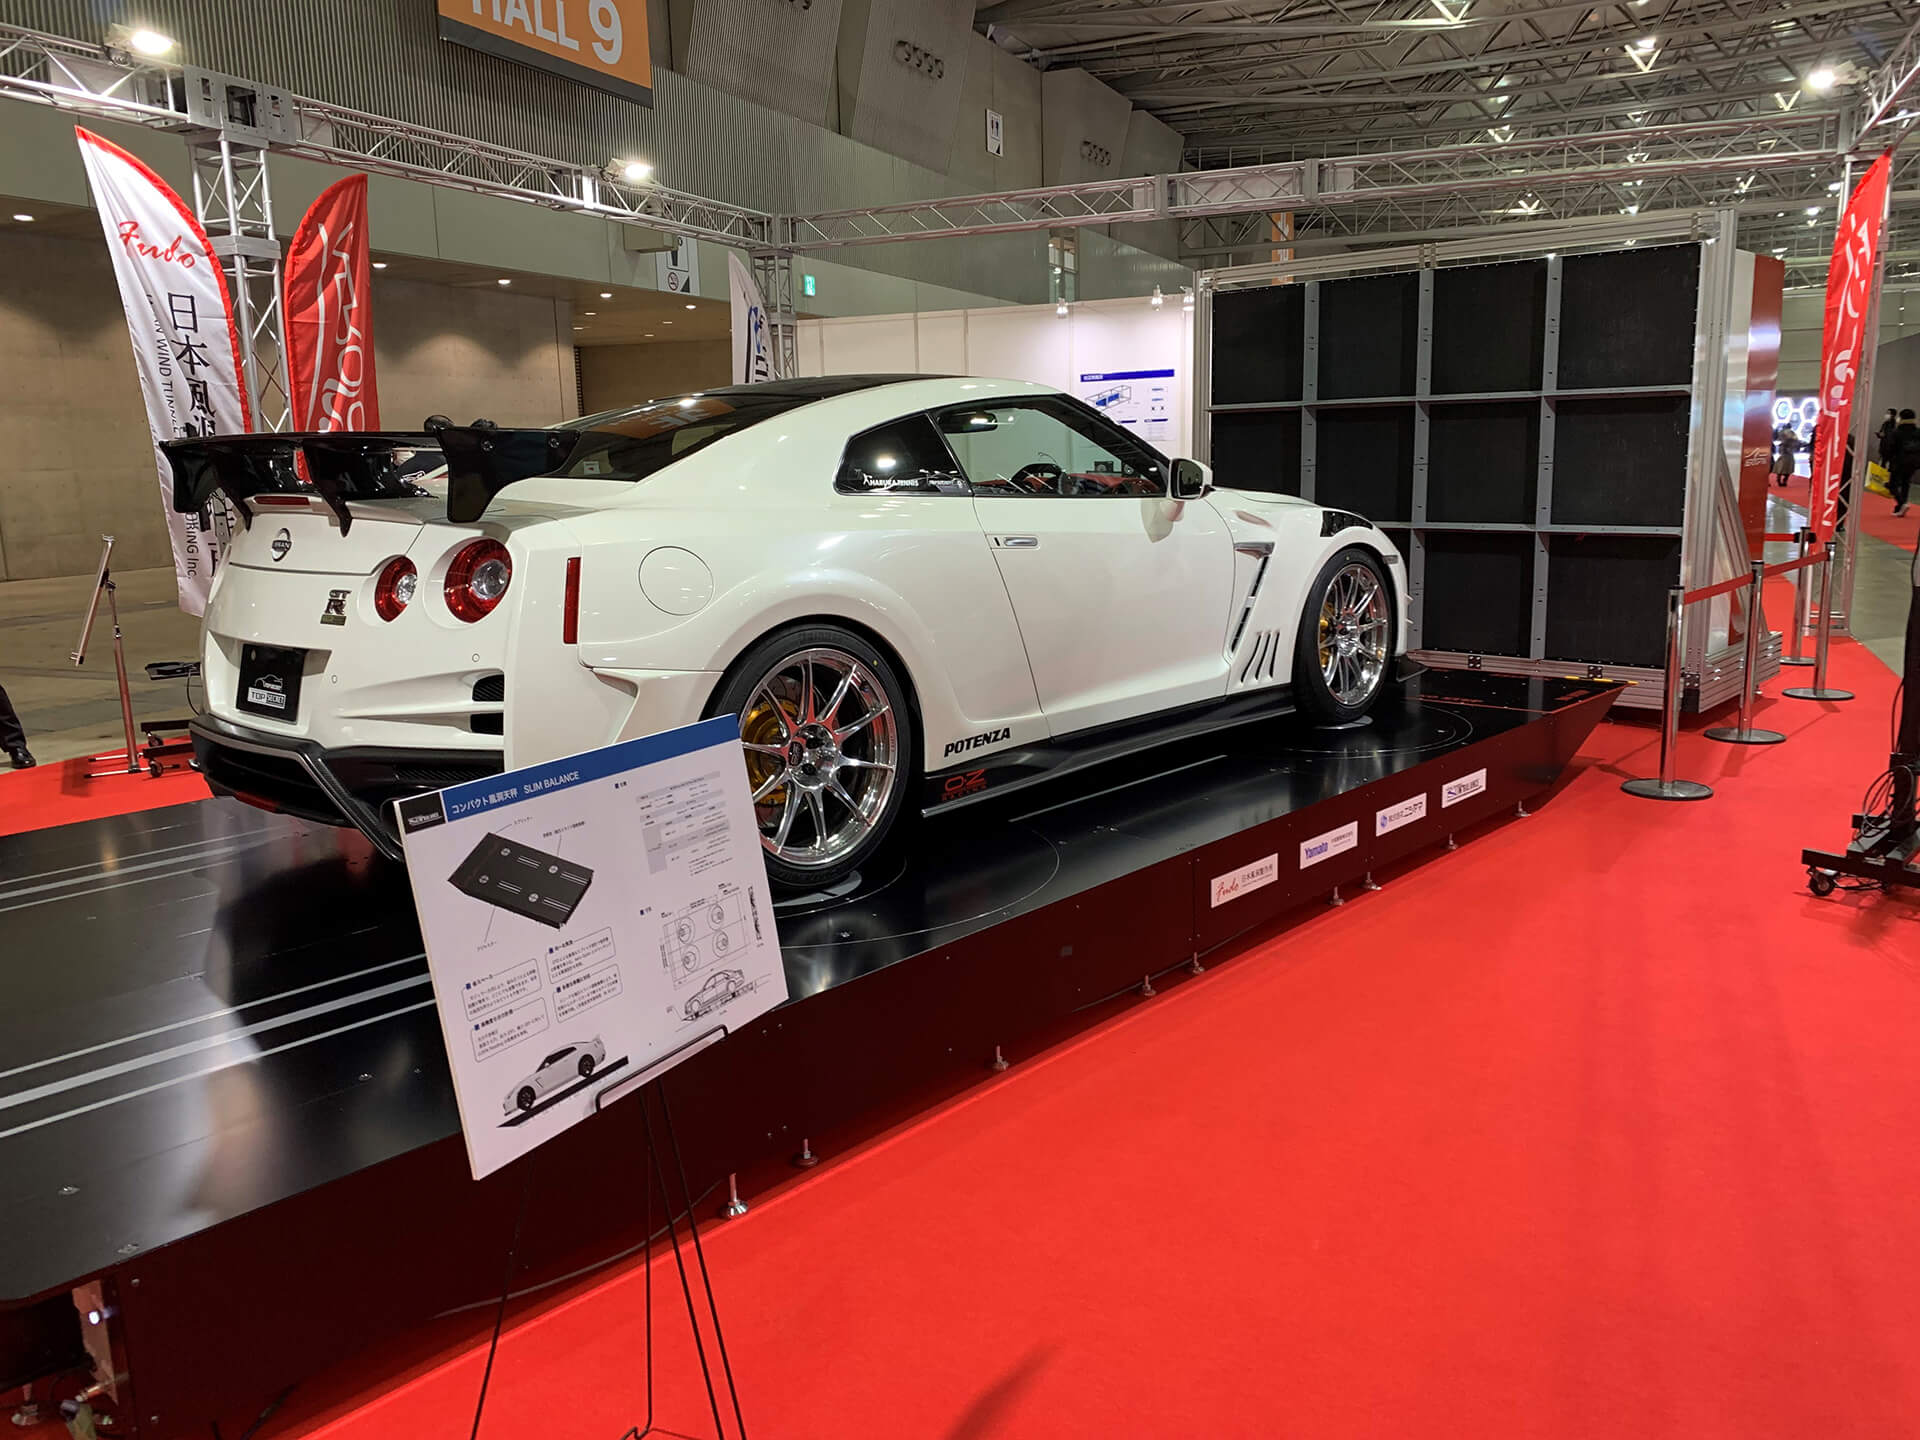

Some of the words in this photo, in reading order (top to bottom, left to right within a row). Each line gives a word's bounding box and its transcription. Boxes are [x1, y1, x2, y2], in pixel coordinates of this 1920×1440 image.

[589, 0, 624, 65] 9
[156, 337, 171, 378] WIND
[186, 557, 200, 580] Inc.
[944, 727, 1011, 758] POTENZA
[524, 781, 544, 795] SLIM
[545, 770, 580, 789] BALANCE
